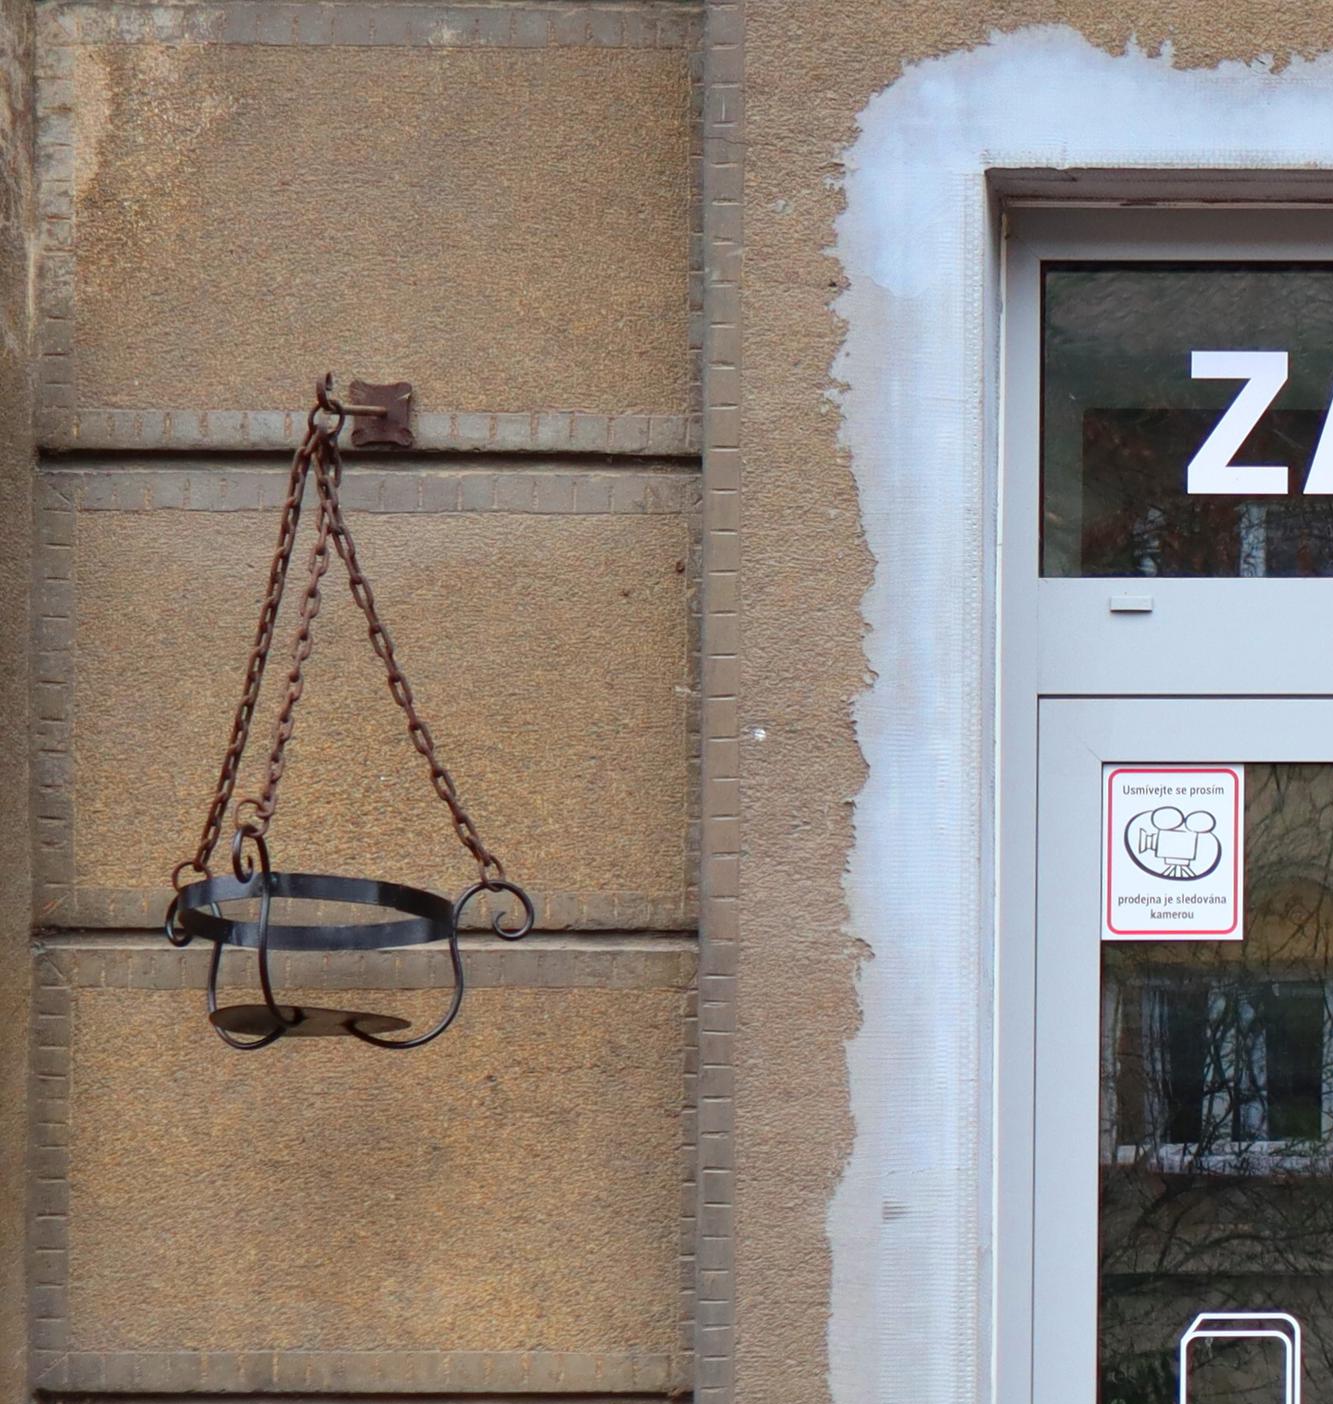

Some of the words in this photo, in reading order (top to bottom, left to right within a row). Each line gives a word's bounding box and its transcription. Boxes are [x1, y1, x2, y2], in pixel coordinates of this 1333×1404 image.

[1123, 784, 1173, 797] Usmívejte
[1176, 786, 1187, 795] se
[1190, 784, 1224, 797] prosím
[1118, 894, 1161, 906] prodejna
[1164, 894, 1173, 906] je
[1176, 894, 1227, 904] sledována
[1150, 909, 1194, 919] kamerou
